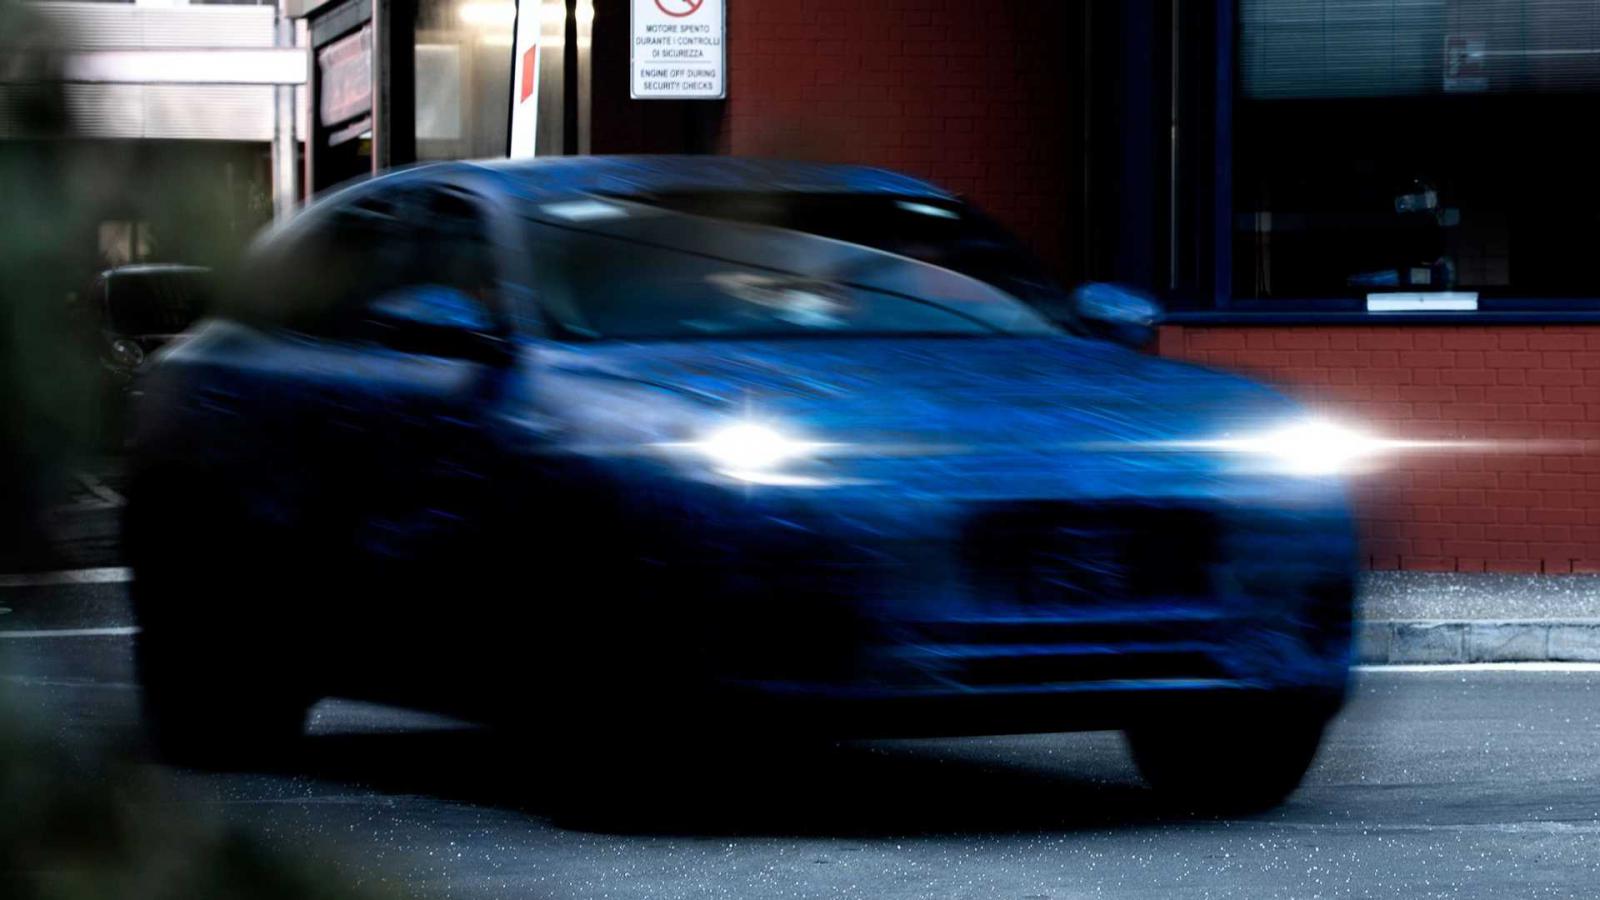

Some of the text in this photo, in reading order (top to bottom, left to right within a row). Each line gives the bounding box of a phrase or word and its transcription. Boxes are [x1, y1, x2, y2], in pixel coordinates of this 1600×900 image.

[646, 24, 710, 33] MOTORE SPENTO
[636, 37, 671, 45] DURANTE
[678, 37, 720, 45] CONTROLLI
[662, 49, 703, 57] SICUREZZA
[640, 69, 716, 78] ENGINE OFF DURING
[643, 82, 713, 90] SECURITY CHECKS
